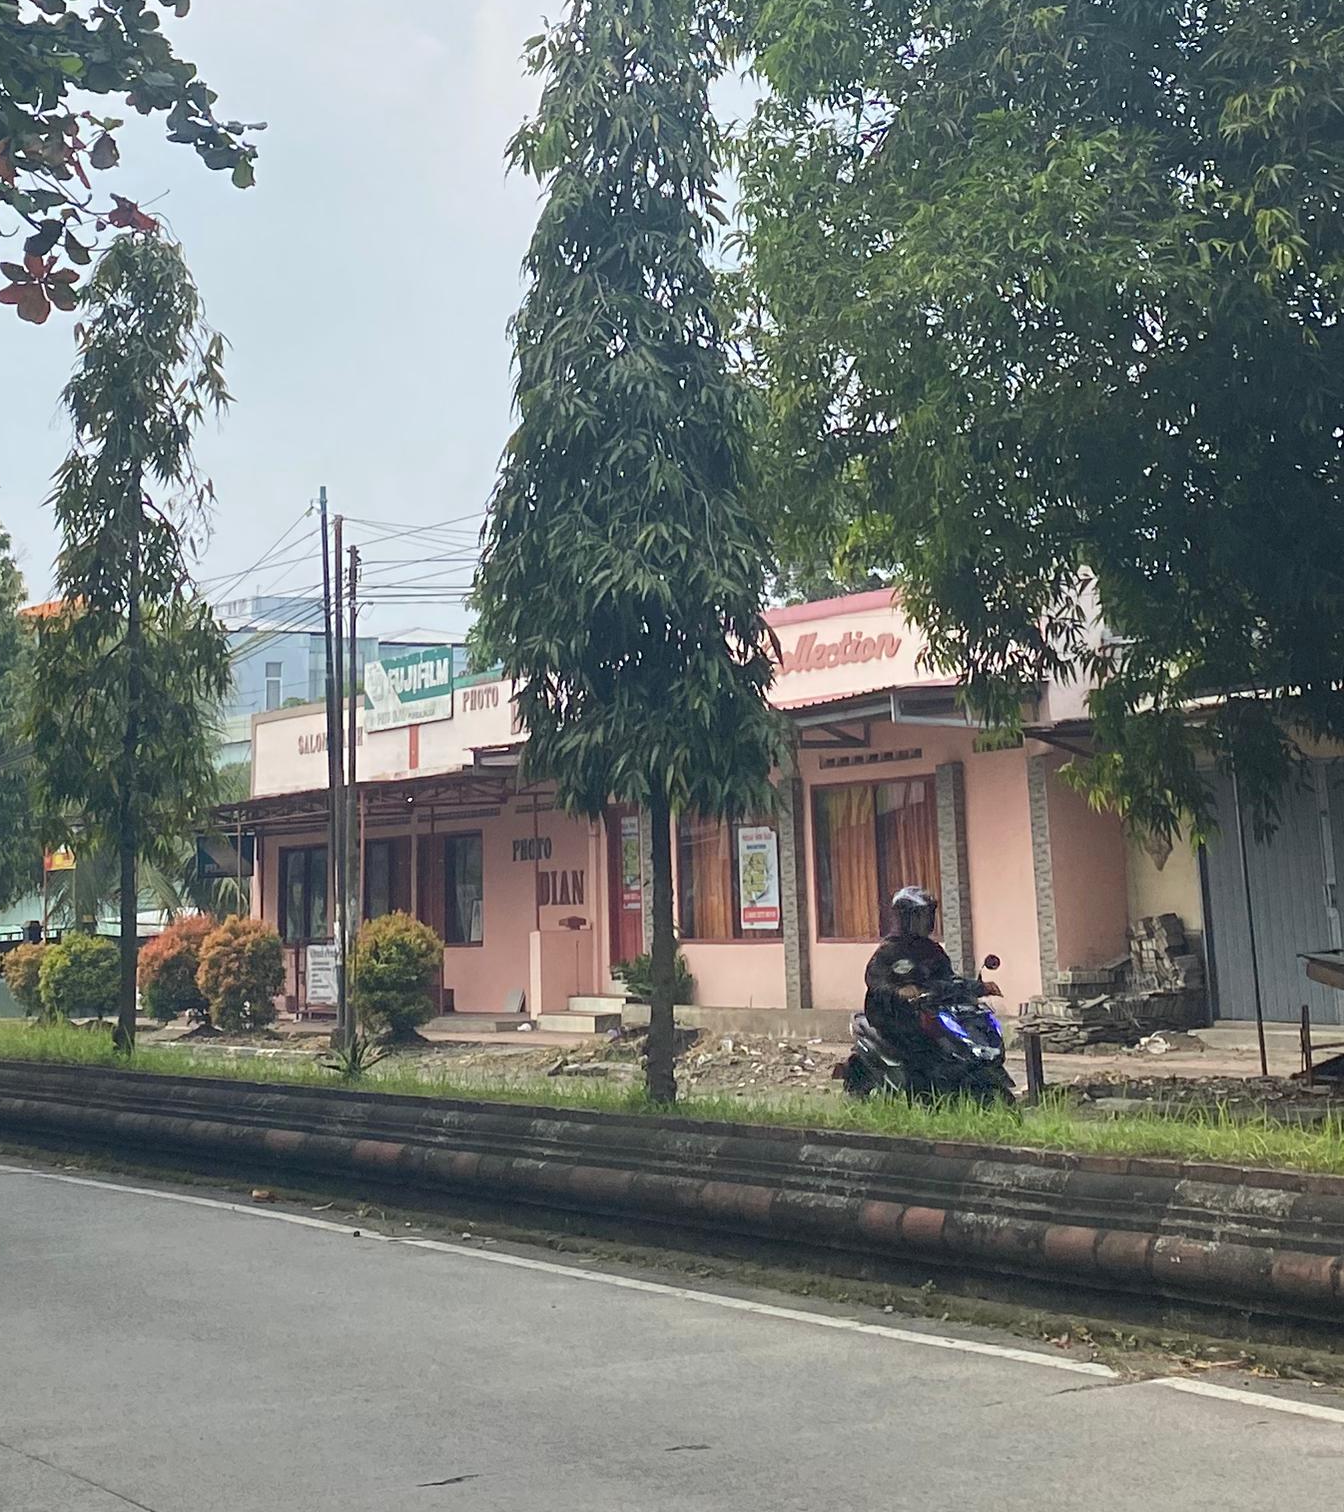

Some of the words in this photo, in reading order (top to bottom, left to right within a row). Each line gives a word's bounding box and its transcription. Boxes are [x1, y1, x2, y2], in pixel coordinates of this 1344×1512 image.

[463, 686, 499, 712] PHOTO
[512, 837, 552, 862] PHOTO
[537, 870, 584, 906] DIAN
